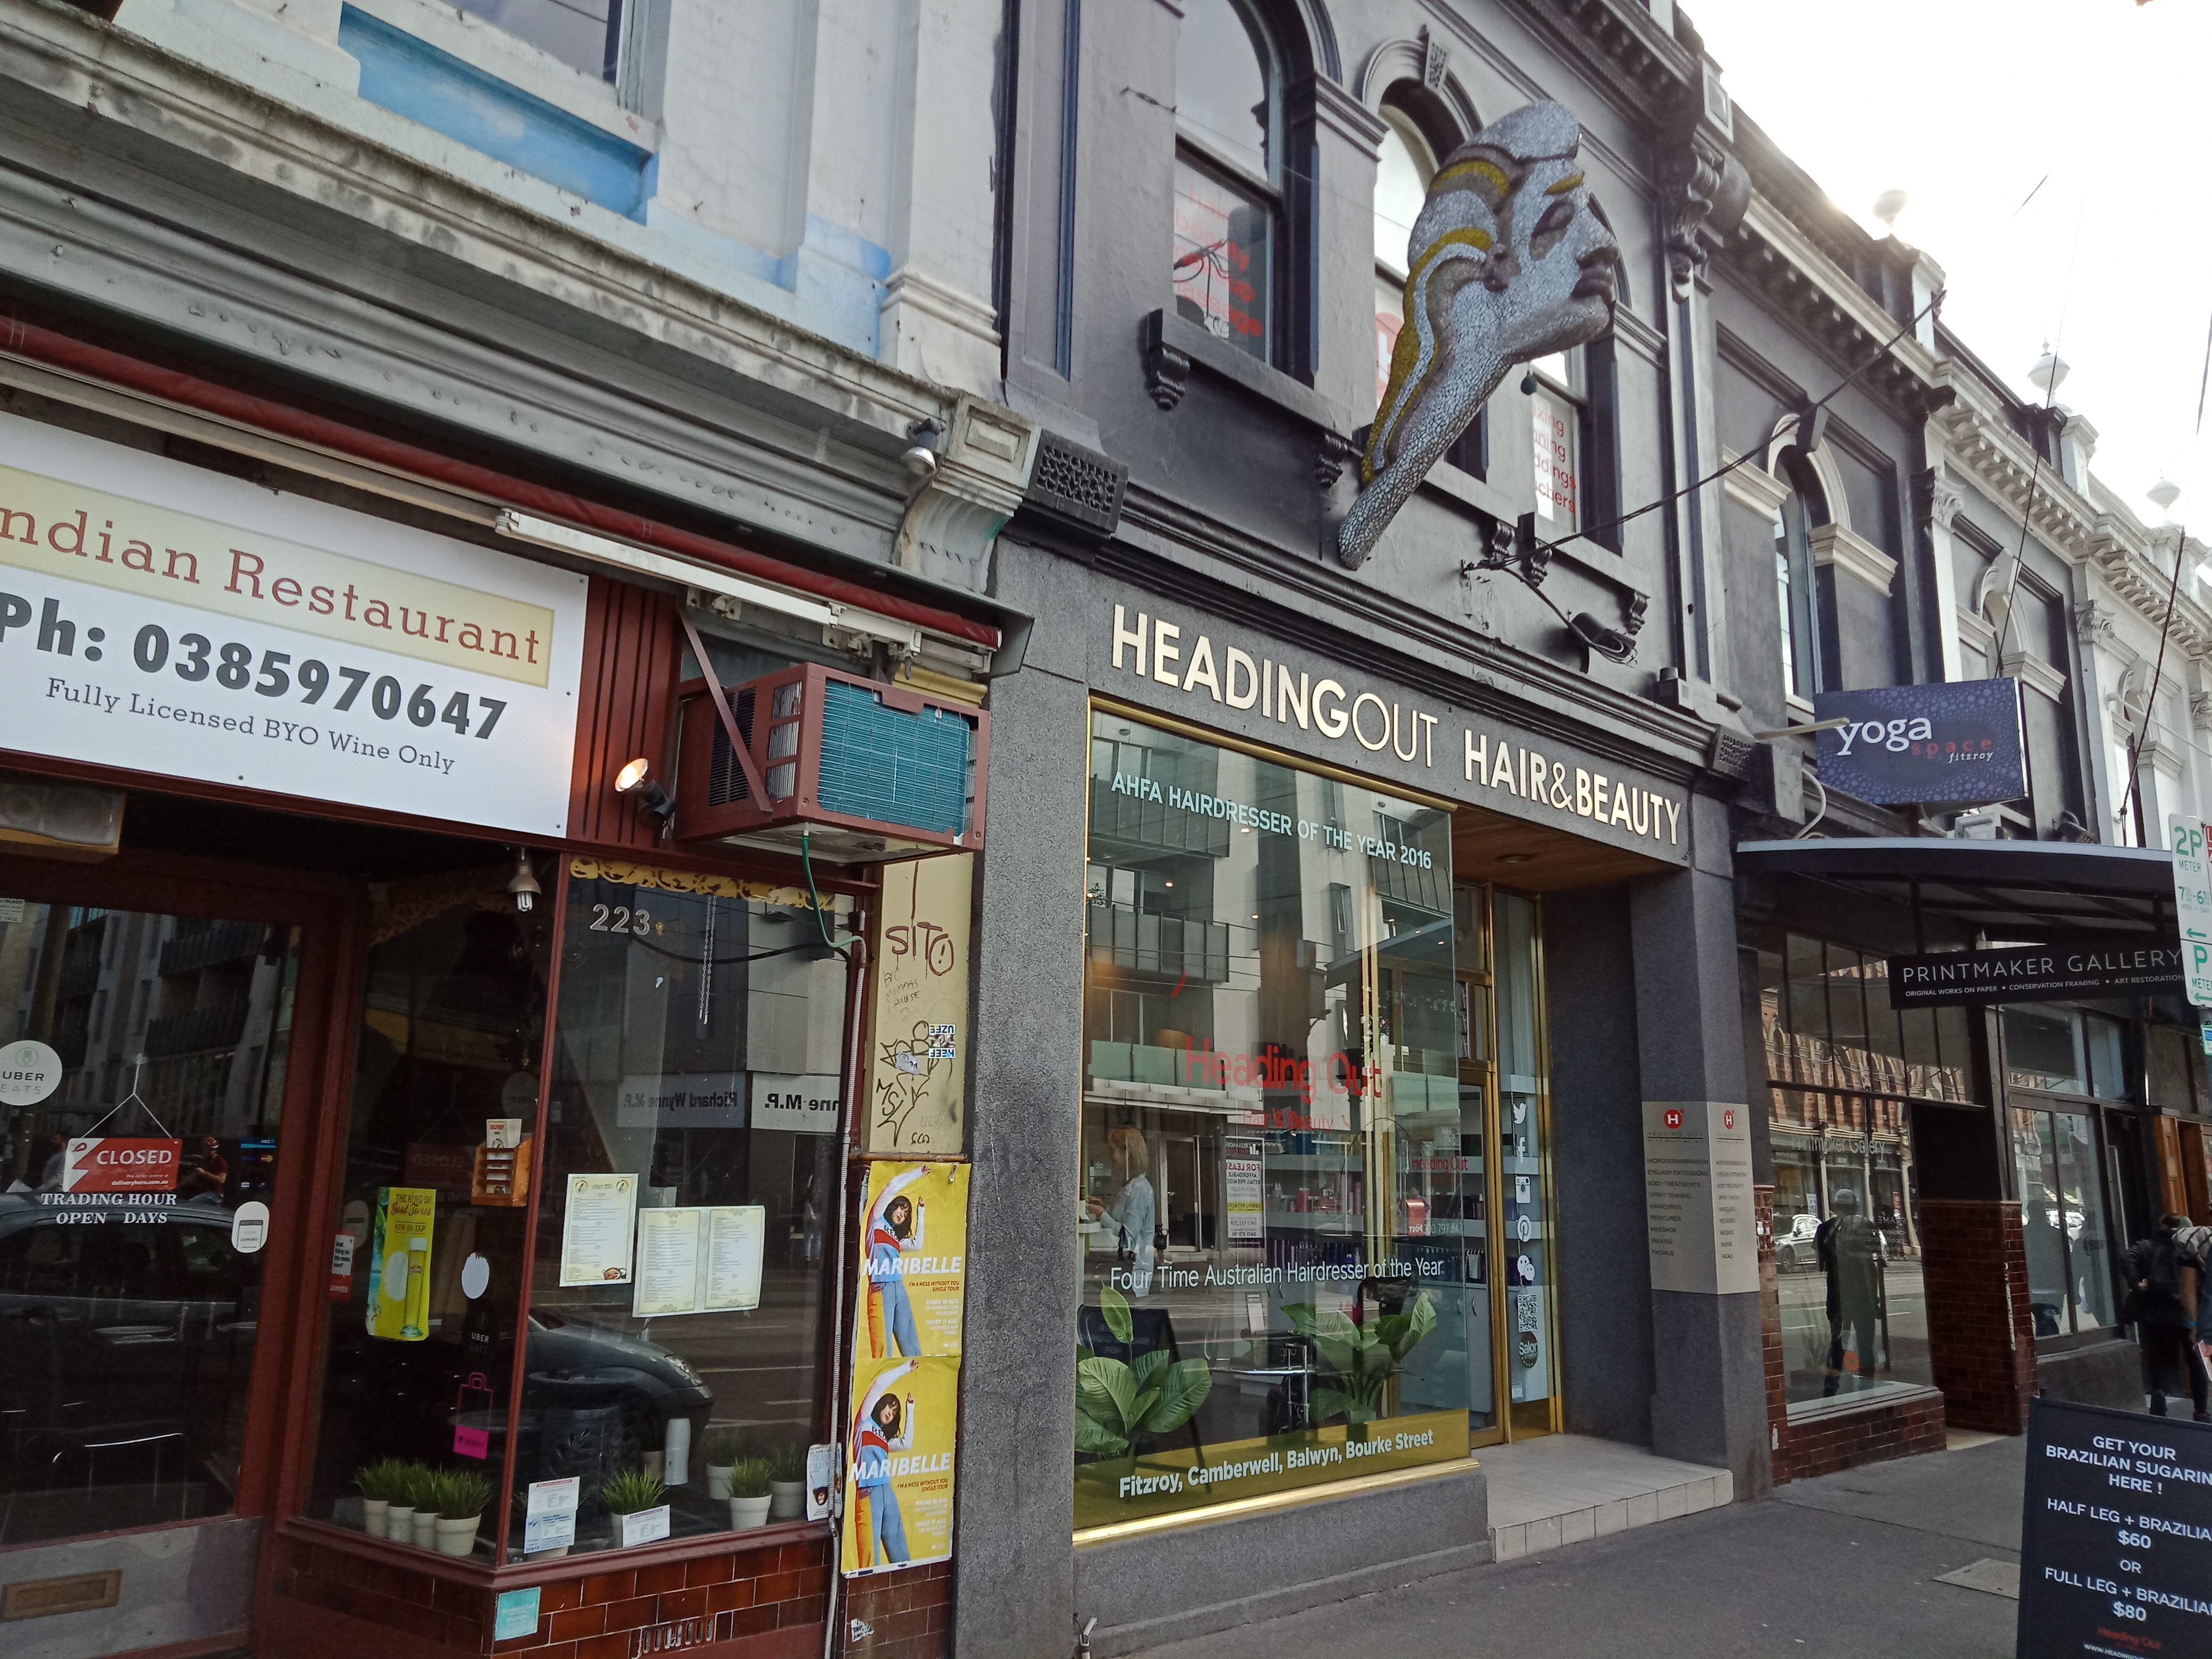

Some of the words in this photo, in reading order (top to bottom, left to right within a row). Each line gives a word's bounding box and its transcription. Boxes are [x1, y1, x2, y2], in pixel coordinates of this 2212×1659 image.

[223, 548, 540, 665] Restaurant
[133, 623, 508, 741] 0385970647
[46, 677, 121, 714] Fully
[129, 693, 254, 735] Licensed
[263, 718, 319, 746] BYO
[328, 730, 390, 760] Wine
[398, 745, 455, 775] Only
[1834, 716, 1933, 757] yoga
[1912, 738, 1992, 759] space
[1948, 750, 1994, 765] fitzroy
[1464, 729, 1682, 845] HAIR&BEAUTY
[1111, 772, 1163, 805] AHFA
[1169, 784, 1292, 836] HAIRDRESSER
[1297, 820, 1318, 842] OF
[1321, 825, 1353, 851] THE
[1356, 835, 1396, 862] YEAR
[1400, 844, 1432, 871] 2016
[2174, 826, 2203, 858] 2P
[2178, 859, 2202, 874] METER
[589, 903, 651, 936] 223
[1903, 957, 2054, 984] PRINTMAKER
[2068, 948, 2182, 974] GALLERY
[2193, 945, 2208, 974] P
[1905, 987, 1941, 997] ORIGINAL
[1942, 987, 1964, 996] WORKS
[1964, 986, 1975, 995] ON
[1976, 985, 1998, 994] PAPER
[2009, 981, 2064, 992] CONSERVATION
[2065, 978, 2100, 988] FRAMING
[2114, 976, 2130, 985] ART
[2131, 973, 2184, 984] RESTORATION
[2, 1071, 45, 1081] UBER
[1185, 1035, 1317, 1104] Heading
[1326, 1051, 1382, 1098] Out
[1, 1084, 41, 1094] EATS
[1243, 1109, 1270, 1128] Hair
[1274, 1109, 1284, 1128] &
[1288, 1111, 1334, 1135] Beauty
[1667, 1114, 1679, 1125] H
[1725, 1115, 1733, 1126] H
[96, 1150, 172, 1165] CLOSED
[1792, 1133, 1846, 1153] Printmaker
[1849, 1133, 1885, 1161] Gallery
[1412, 1156, 1449, 1174] Heading
[1451, 1155, 1468, 1170] Out
[41, 1193, 123, 1205] TRADING
[127, 1193, 178, 1205] HOUR
[408, 1194, 422, 1203] KING
[56, 1212, 108, 1225] OPEN
[123, 1212, 168, 1224] DAYS
[395, 1223, 405, 1231] NOW
[861, 1256, 962, 1276] MARIBELLE
[1110, 1266, 1153, 1292] Four
[1157, 1264, 1199, 1288] Time
[1204, 1262, 1281, 1287] Australian
[1286, 1261, 1371, 1284] Hairdresser
[1373, 1260, 1389, 1279] of
[1389, 1259, 1412, 1277] the
[1415, 1256, 1444, 1277] Year
[471, 1332, 489, 1344] UBER
[2046, 1445, 2131, 1471] BRAZILIAN
[2093, 1436, 2125, 1453] GET
[2129, 1440, 2176, 1461] YOUR
[849, 1453, 951, 1482] MARIBELLE
[1119, 1471, 1184, 1499] Fitzroy,
[1187, 1451, 1284, 1488] Camberwell,
[1286, 1445, 1344, 1470] Balwyn,
[1345, 1434, 1393, 1460] Bourke
[1395, 1428, 1435, 1451] Street
[2109, 1473, 2152, 1493] HERE
[2158, 1481, 2163, 1495] !
[2047, 1497, 2087, 1516] HALF
[2090, 1506, 2120, 1523] LEG
[2124, 1515, 2135, 1526] +
[2118, 1529, 2152, 1549] $60
[2120, 1559, 2142, 1574] OR
[2045, 1566, 2083, 1588] FULL
[2087, 1576, 2117, 1595] LEG
[2122, 1587, 2132, 1597] +
[2113, 1601, 2147, 1622] $80
[2097, 1626, 2140, 1646] Heading
